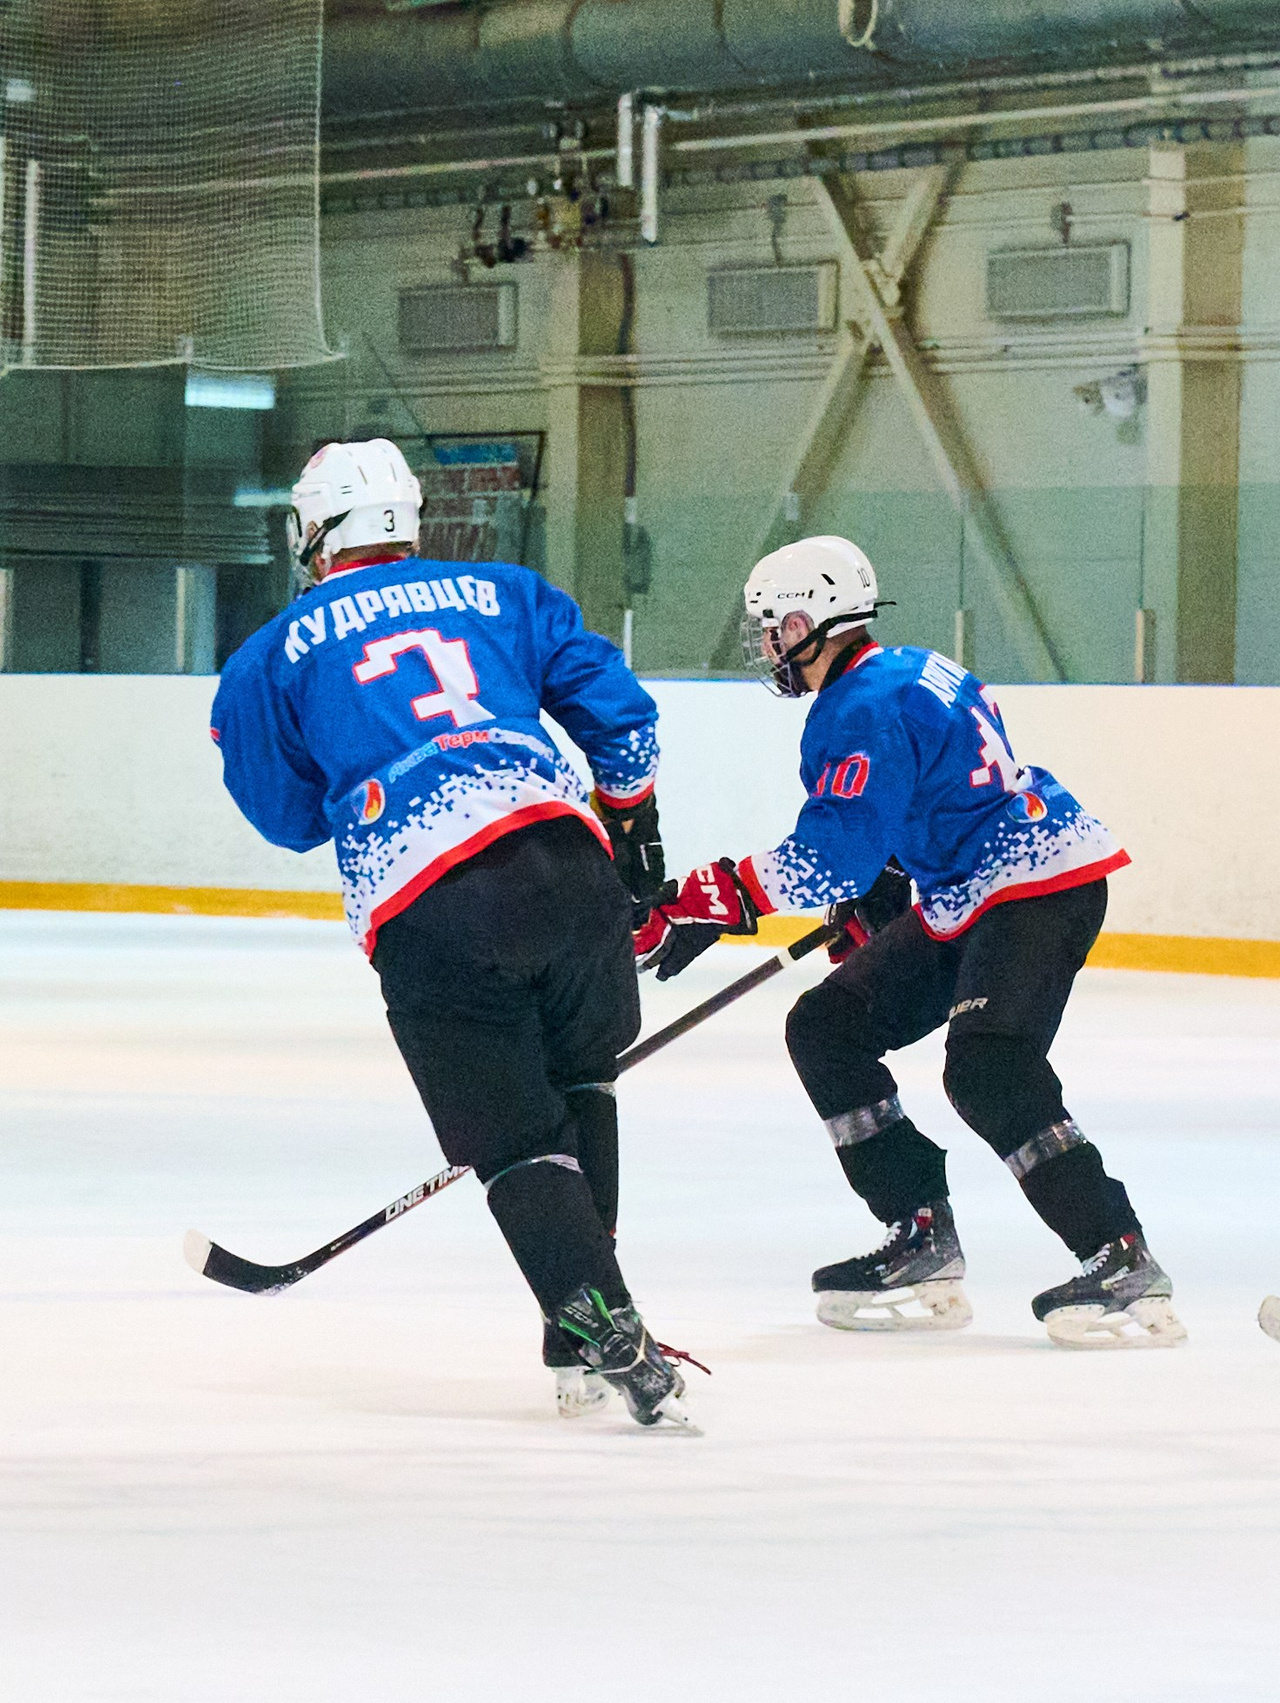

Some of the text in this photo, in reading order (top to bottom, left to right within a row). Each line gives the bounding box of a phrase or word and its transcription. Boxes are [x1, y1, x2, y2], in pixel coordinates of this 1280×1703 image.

[384, 509, 395, 532] 3
[778, 591, 805, 599] CCM
[696, 863, 729, 916] CM
[949, 997, 988, 1019] UER
[385, 1184, 425, 1221] ONE
